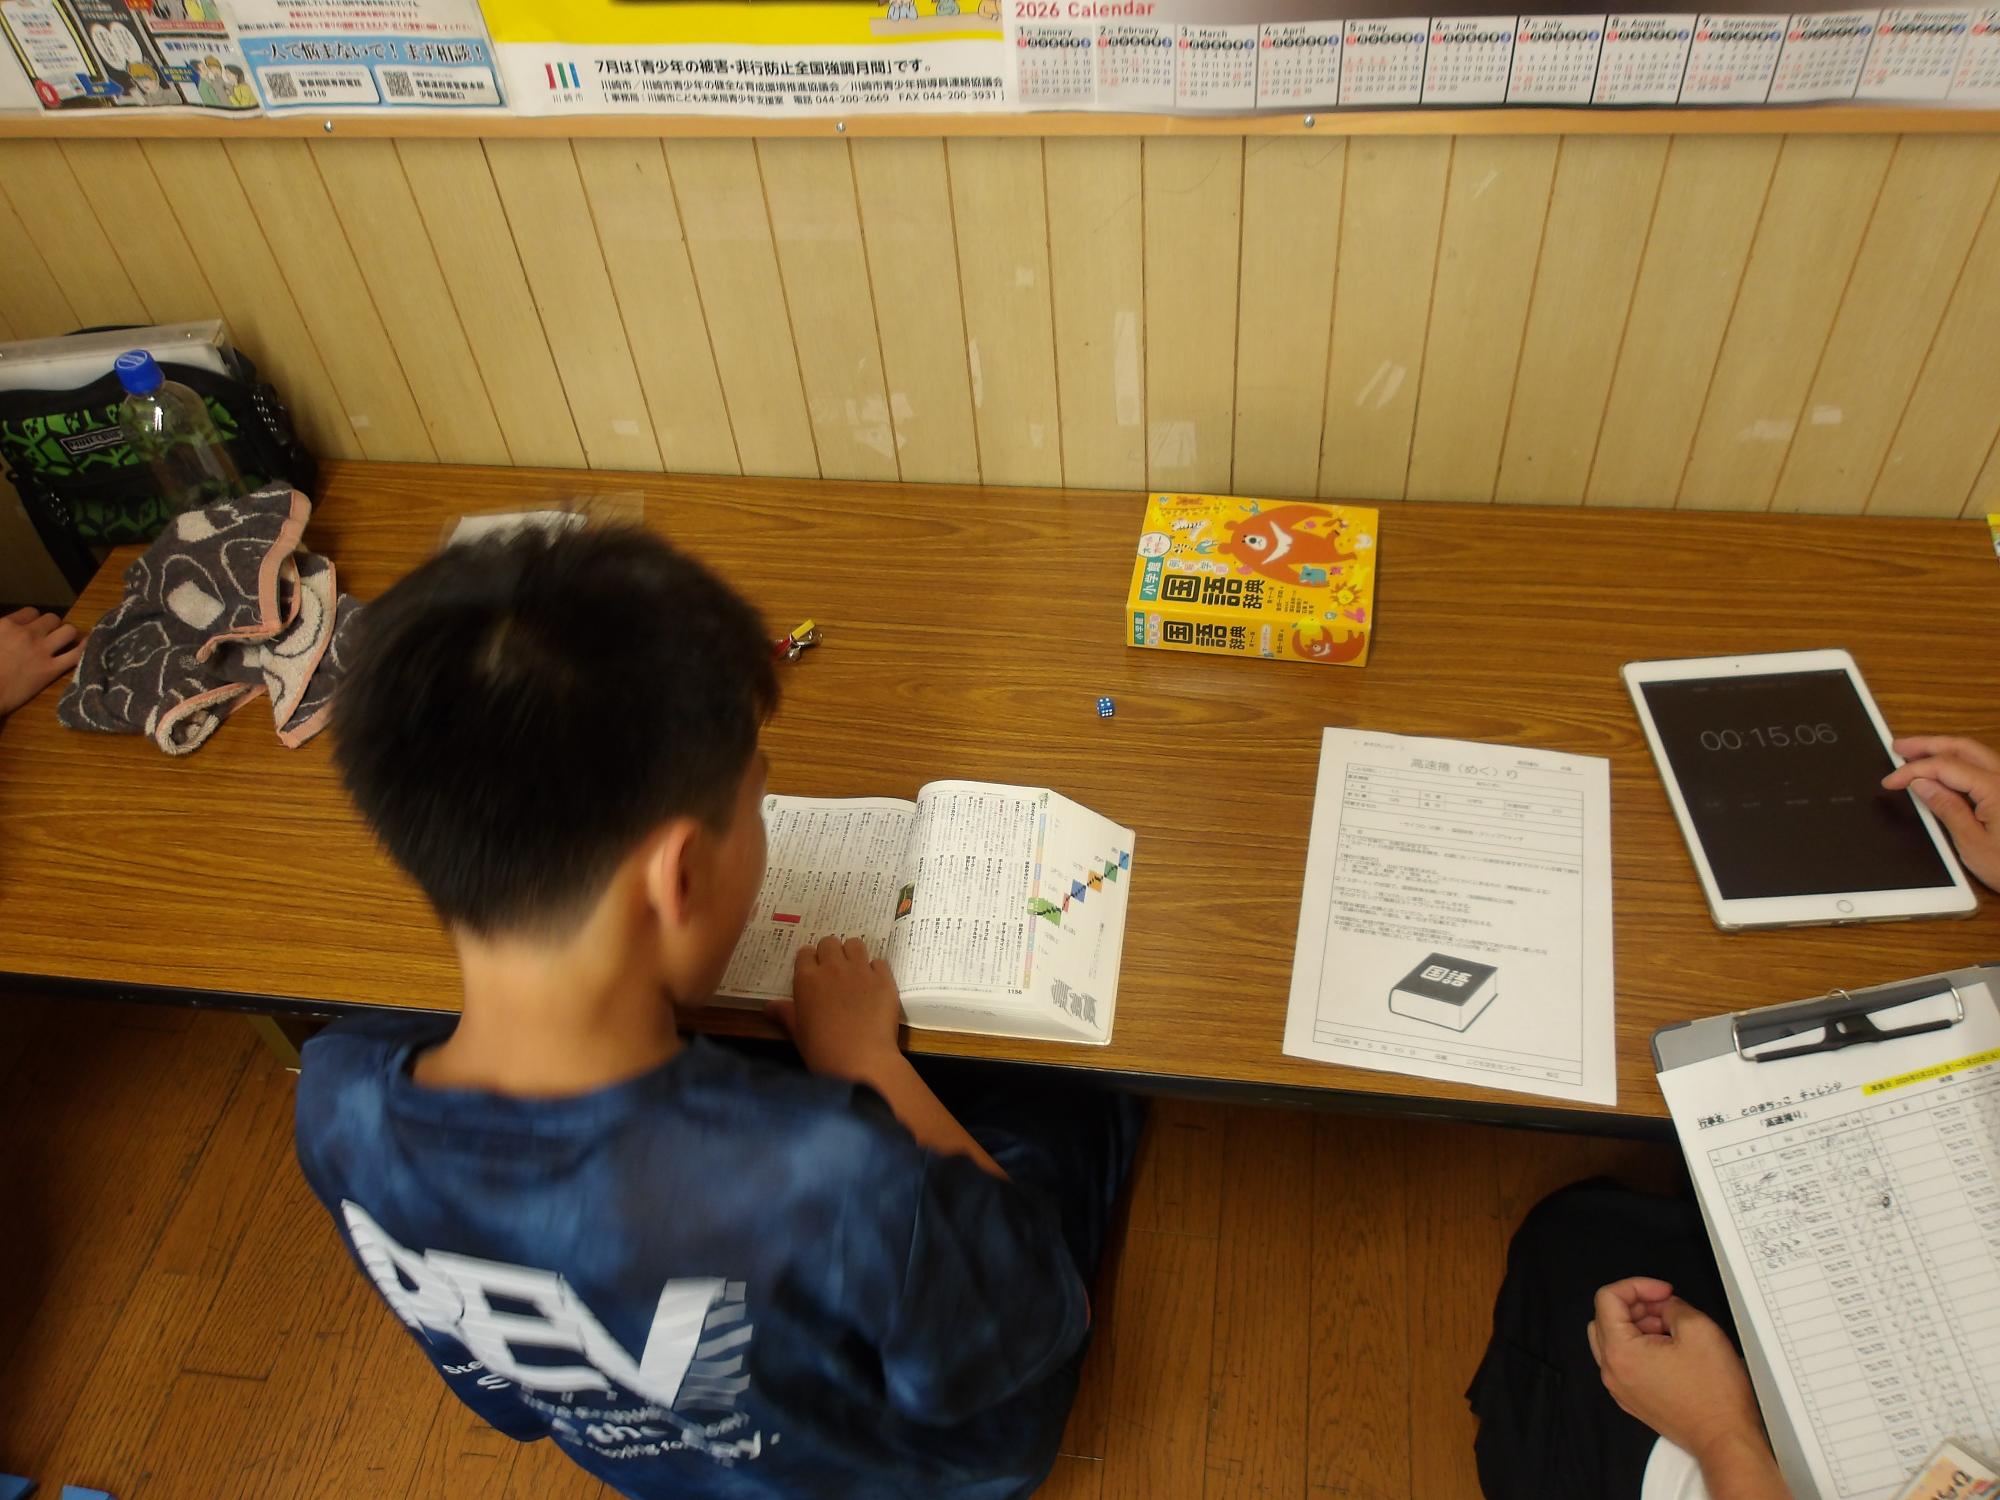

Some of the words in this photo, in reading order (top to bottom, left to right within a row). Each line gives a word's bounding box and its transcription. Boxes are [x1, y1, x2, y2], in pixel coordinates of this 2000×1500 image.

[1015, 2, 1060, 18] 2026
[1068, 0, 1155, 17] Calendar
[1368, 24, 1387, 33] May
[1456, 23, 1478, 31] June
[1631, 19, 1666, 30] August
[1038, 28, 1072, 38] January
[1118, 27, 1159, 38] February
[1199, 28, 1228, 38] March
[1283, 26, 1306, 37] April
[404, 42, 484, 62] まず相談！
[594, 58, 931, 76] 7月は「青少年の被害・非行防止全国強調月間」です。
[1143, 561, 1161, 595] 小学館
[1700, 723, 1839, 752] 00:15.06
[1420, 965, 1473, 988] 国語
